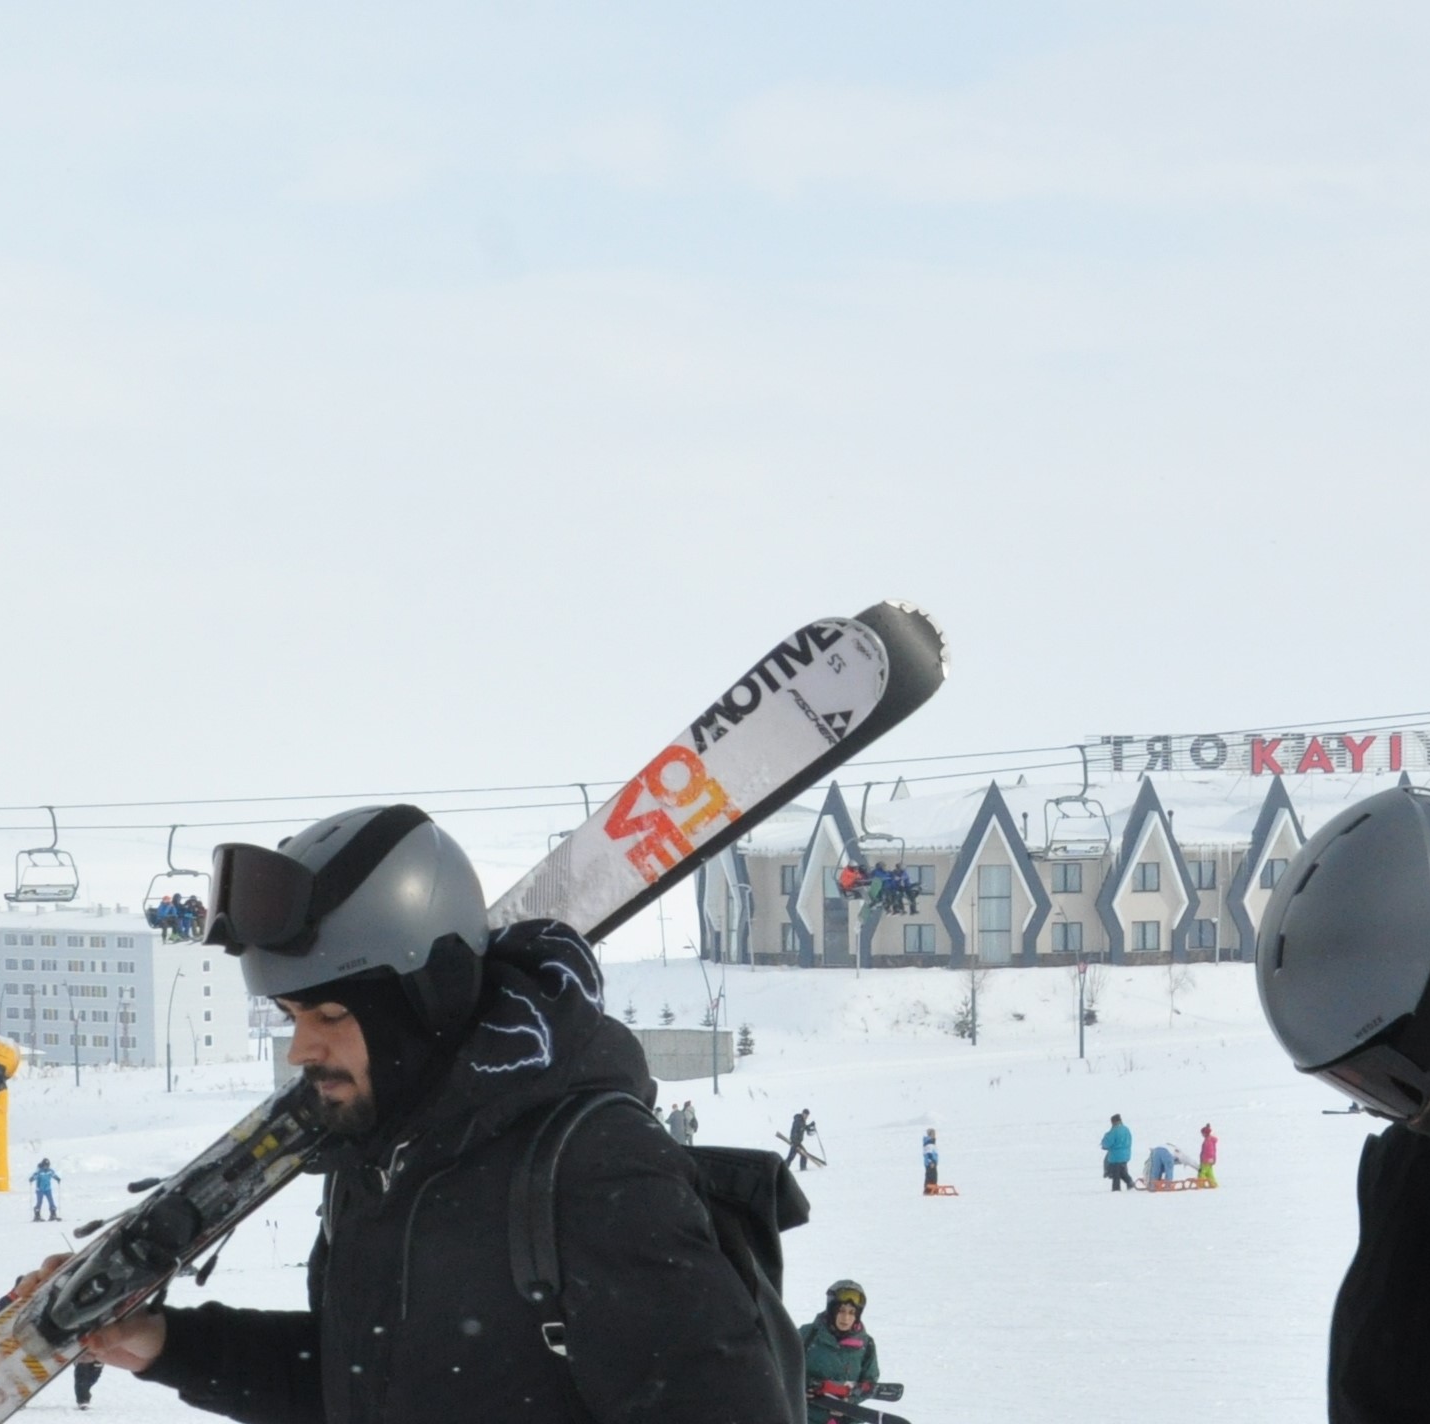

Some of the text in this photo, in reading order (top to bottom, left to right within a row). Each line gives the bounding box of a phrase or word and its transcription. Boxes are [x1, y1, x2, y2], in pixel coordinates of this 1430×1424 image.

[689, 623, 844, 756] MOTIVE
[786, 688, 841, 746] FISCHER
[1251, 732, 1402, 775] KAYI
